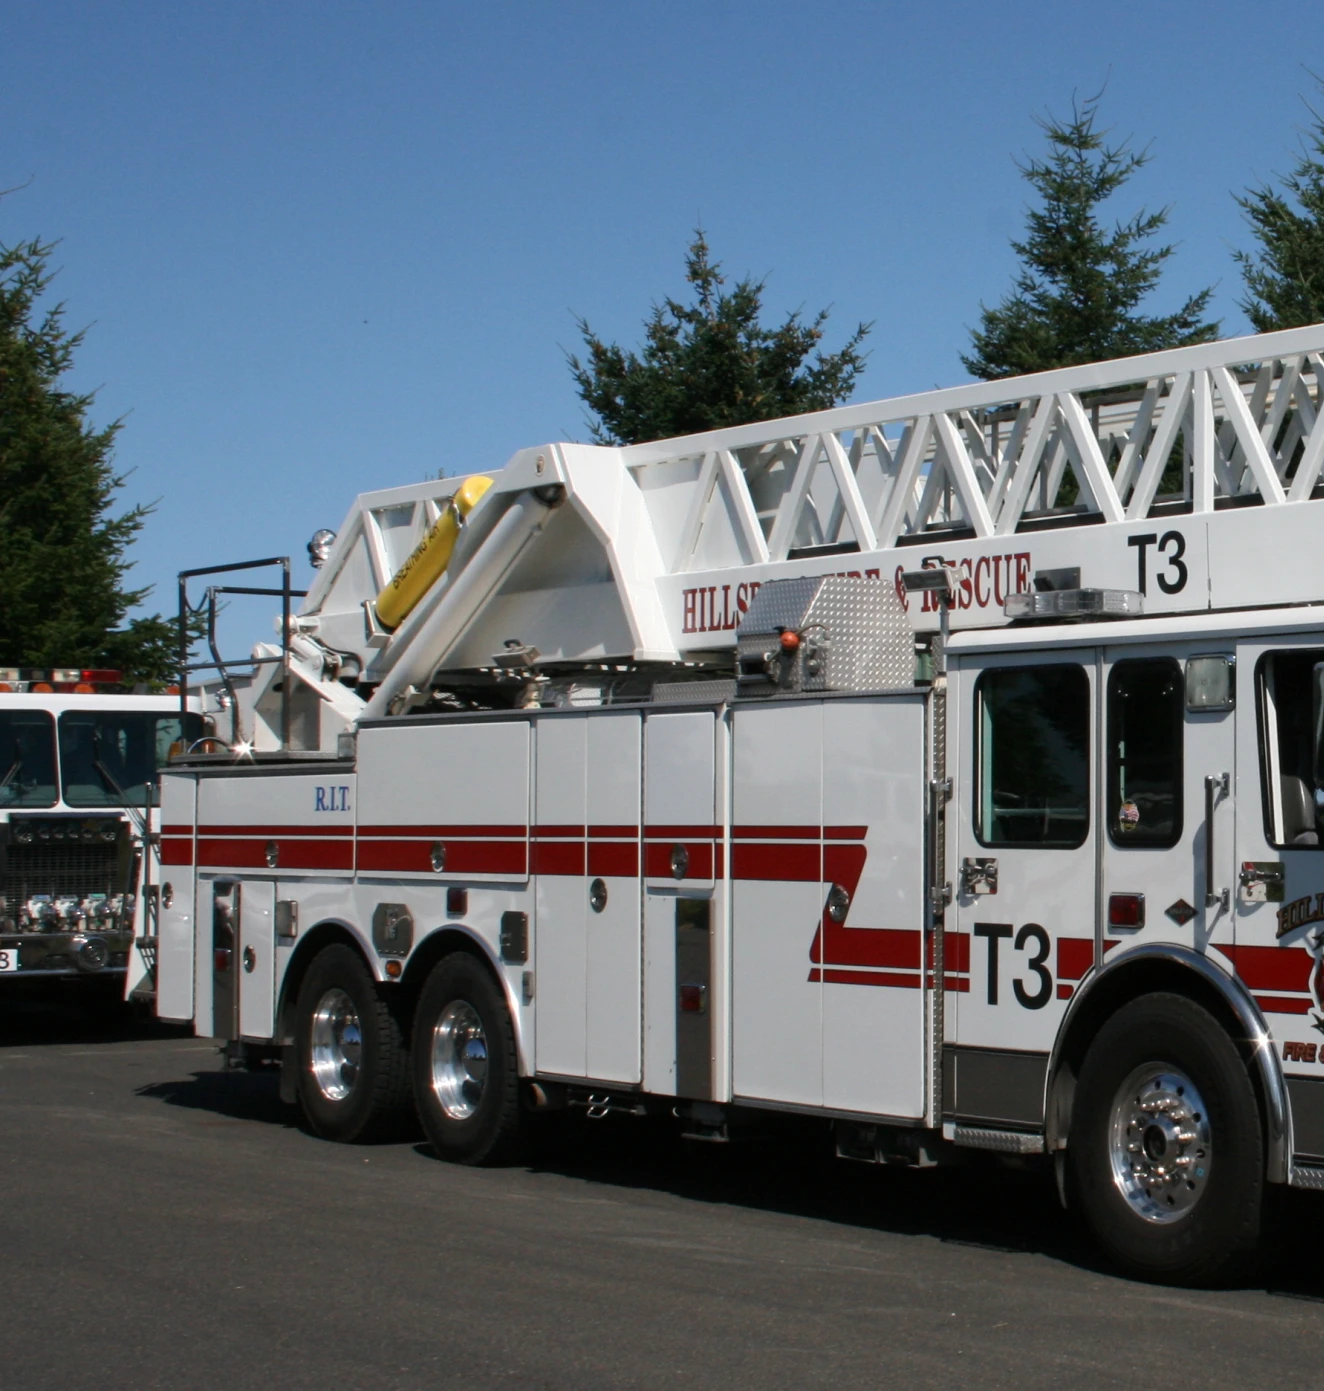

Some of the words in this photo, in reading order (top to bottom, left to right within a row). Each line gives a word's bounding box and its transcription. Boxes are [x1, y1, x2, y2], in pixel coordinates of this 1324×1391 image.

[1127, 530, 1188, 595] T3
[314, 786, 351, 812] R.I.T.
[974, 922, 1053, 1010] T3
[1283, 1041, 1317, 1063] FIRE
